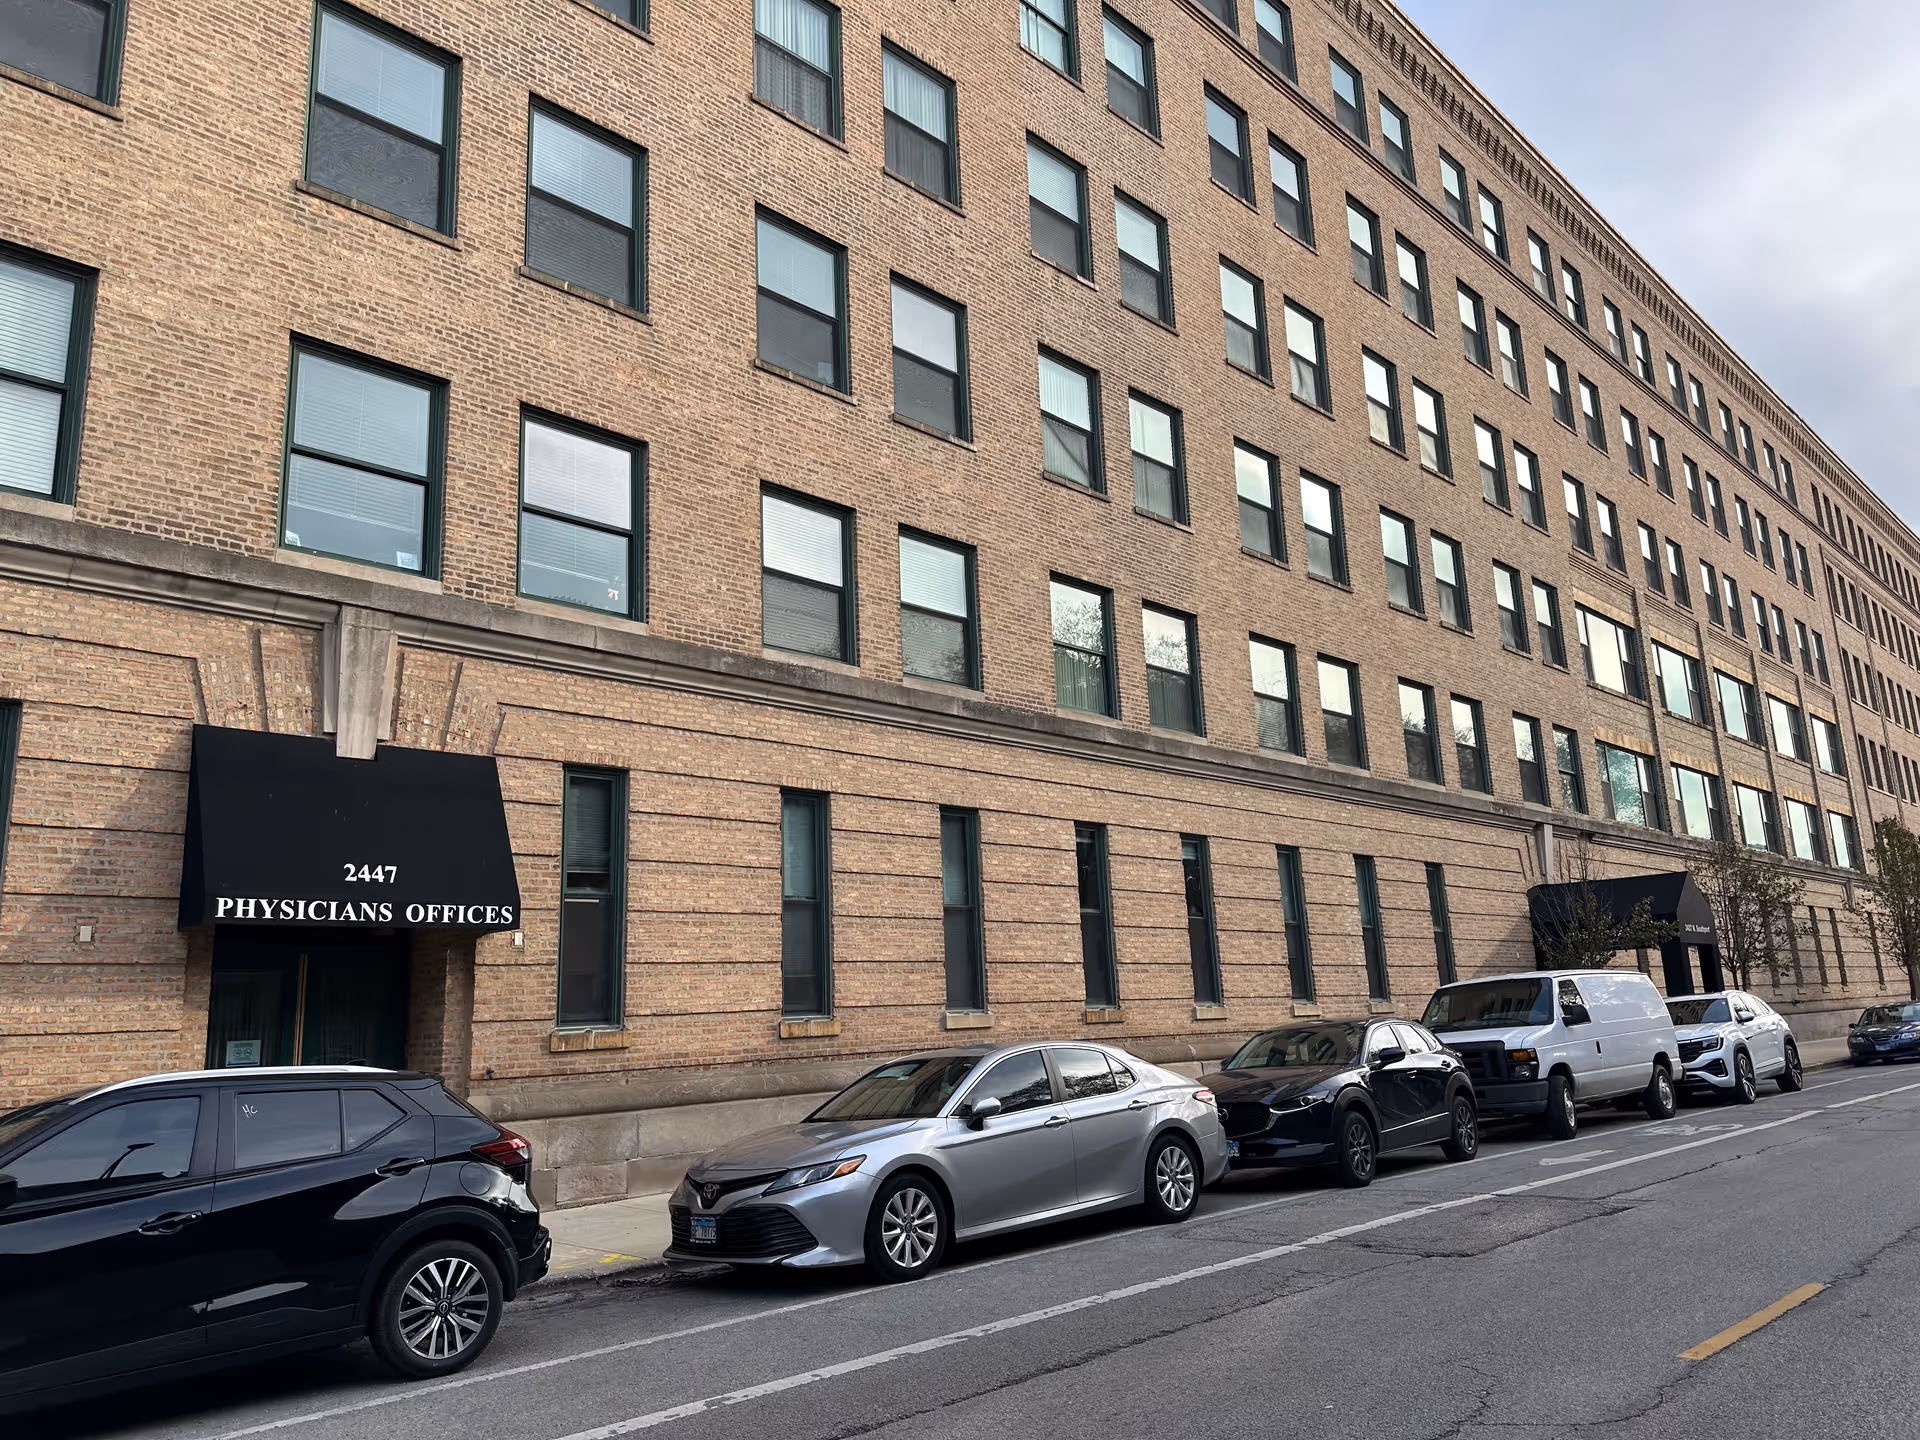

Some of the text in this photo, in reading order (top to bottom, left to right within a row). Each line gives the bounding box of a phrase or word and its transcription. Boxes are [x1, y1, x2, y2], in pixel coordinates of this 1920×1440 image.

[343, 863, 398, 884] 2447
[214, 897, 514, 925] PHYSICIANS OFFICES
